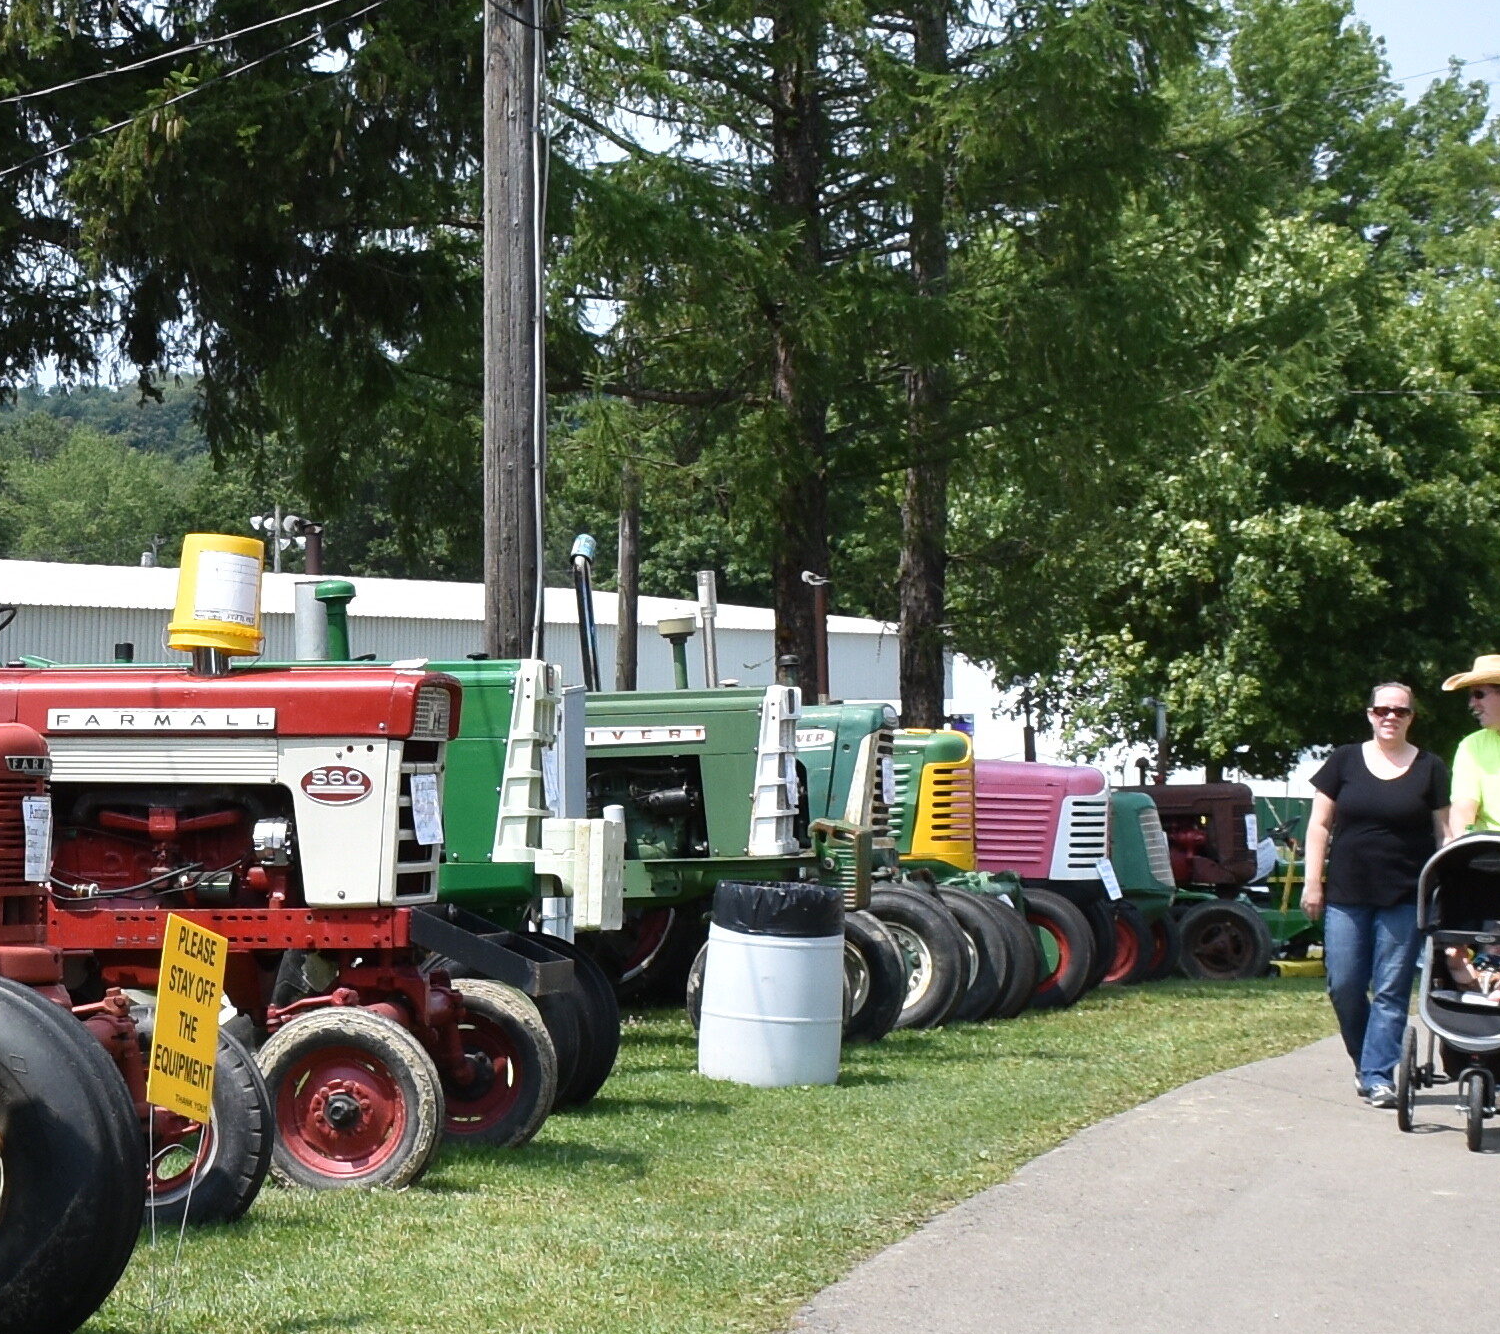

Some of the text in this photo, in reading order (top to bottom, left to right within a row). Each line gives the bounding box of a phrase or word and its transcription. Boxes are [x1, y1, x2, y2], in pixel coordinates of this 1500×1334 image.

[56, 713, 270, 727] FARMALL
[311, 769, 364, 786] 560
[177, 925, 218, 967] PLEASE
[168, 964, 216, 1007] STAY OFF
[178, 1010, 199, 1044] THE
[153, 1044, 213, 1091] EQUIPMENT
[175, 1093, 193, 1109] THANK
